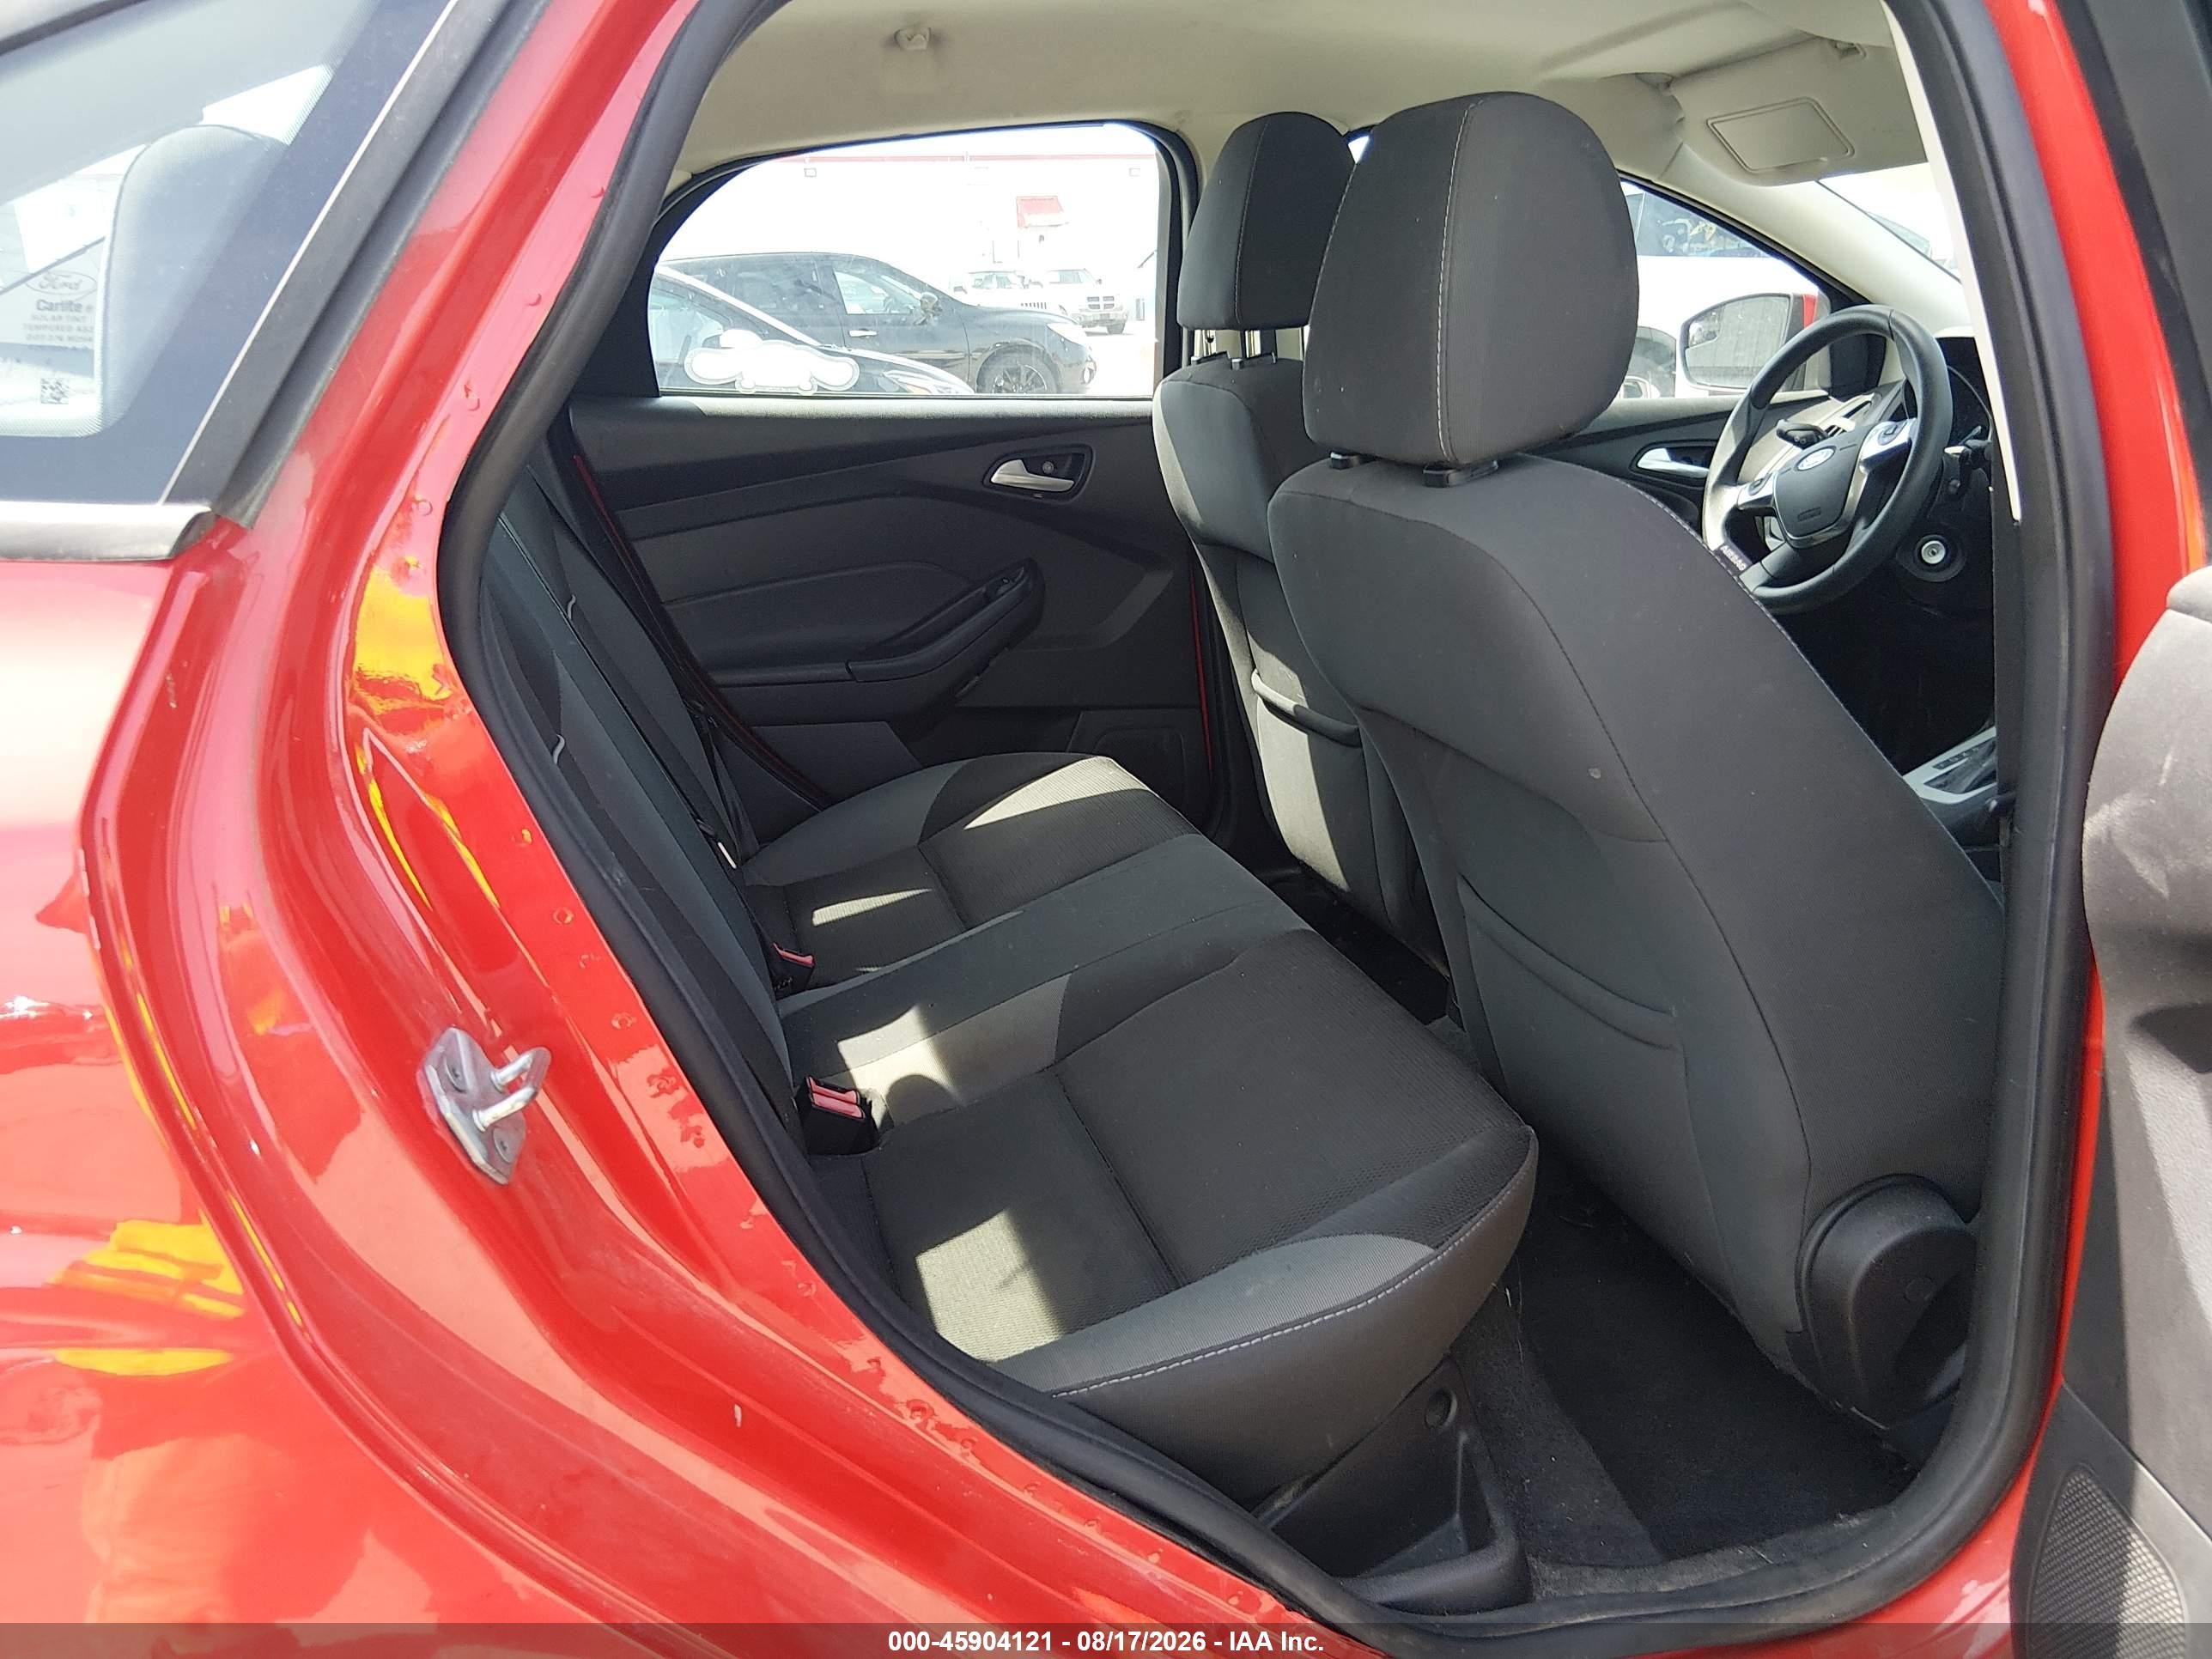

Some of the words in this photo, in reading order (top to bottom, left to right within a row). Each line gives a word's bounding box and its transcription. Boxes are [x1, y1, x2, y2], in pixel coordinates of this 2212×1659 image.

[39, 274, 82, 290] Ford
[36, 299, 82, 313] Carlite
[1720, 545, 1747, 571] AIRBAG
